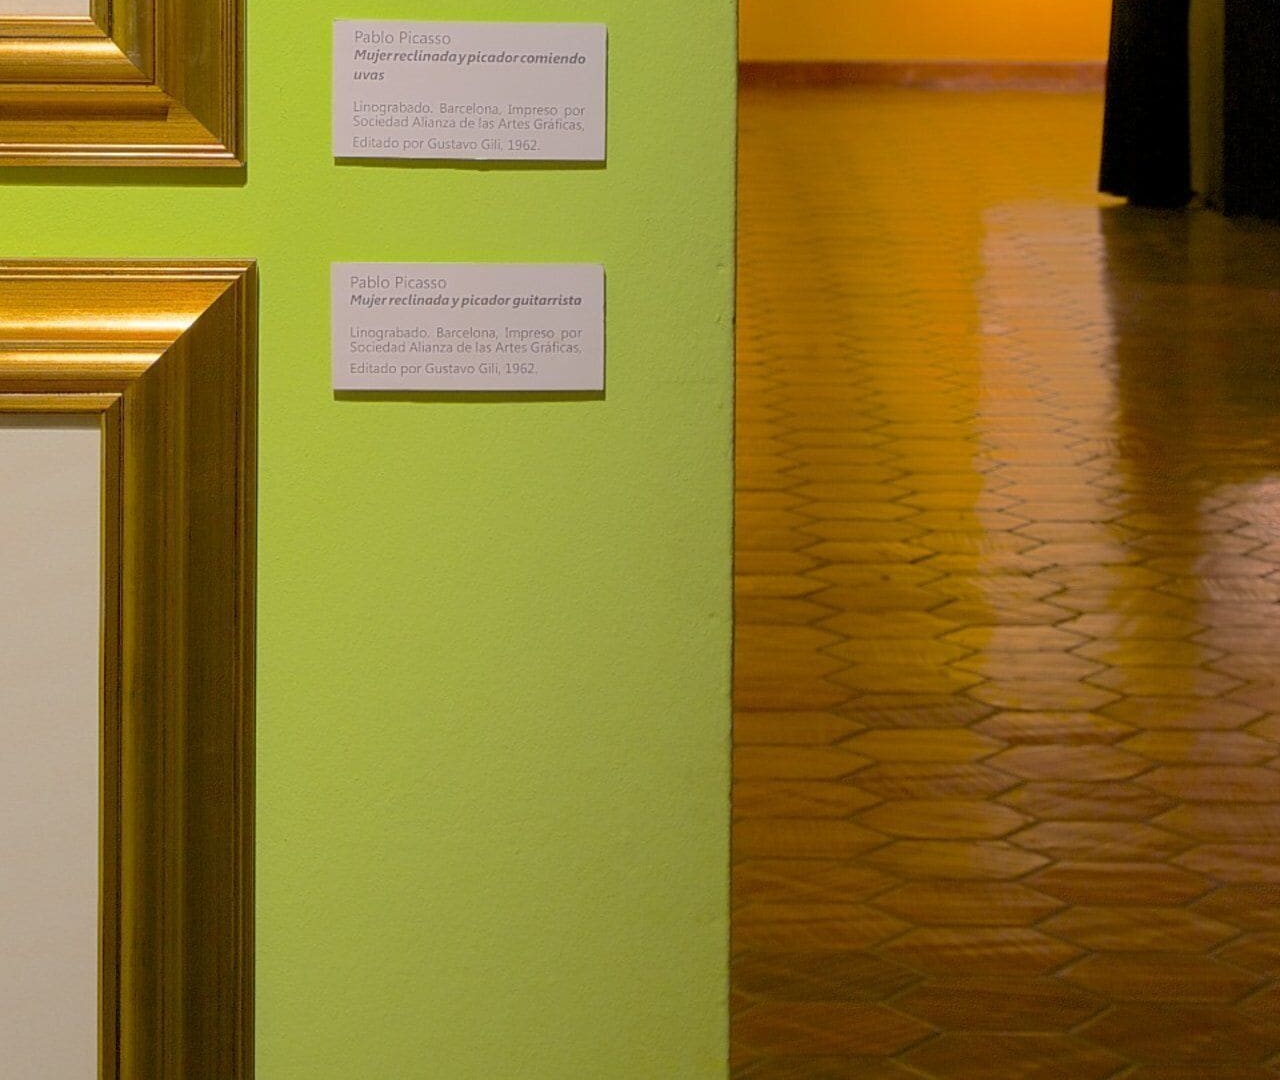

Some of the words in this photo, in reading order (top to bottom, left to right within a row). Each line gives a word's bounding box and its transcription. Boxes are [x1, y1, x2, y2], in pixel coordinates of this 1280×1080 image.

[355, 30, 394, 44] Pablo
[399, 30, 452, 45] Picasso
[354, 49, 393, 64] Mujer
[393, 50, 457, 62] reclinada
[456, 53, 466, 66] y
[467, 51, 520, 66] picador
[520, 52, 587, 65] comiendo
[353, 71, 385, 81] uvas
[508, 103, 559, 117] Impreso
[564, 106, 586, 118] por
[352, 115, 409, 127] Sociedad
[412, 116, 456, 128] Alianza
[459, 117, 475, 129] de
[478, 118, 495, 129] las
[498, 118, 530, 130] Artes
[352, 136, 399, 149] Editado
[403, 139, 424, 151] por
[427, 137, 478, 150] Gustavo
[508, 139, 541, 151] 1962.
[350, 274, 390, 289] Pablo
[395, 275, 447, 290] Picasso
[350, 294, 387, 309] Mujer
[389, 293, 450, 306] reclinada
[450, 297, 460, 309] y
[460, 294, 511, 308] picador
[512, 294, 582, 309] guitarrista
[505, 326, 555, 342] Impreso
[560, 329, 583, 342] por
[350, 341, 406, 353] Sociedad
[409, 341, 453, 353] Alianza
[456, 341, 473, 353] de
[475, 341, 492, 353] las
[495, 342, 528, 353] Artes
[350, 361, 397, 374] Editado
[401, 365, 422, 377] por
[424, 363, 475, 374] Gustavo
